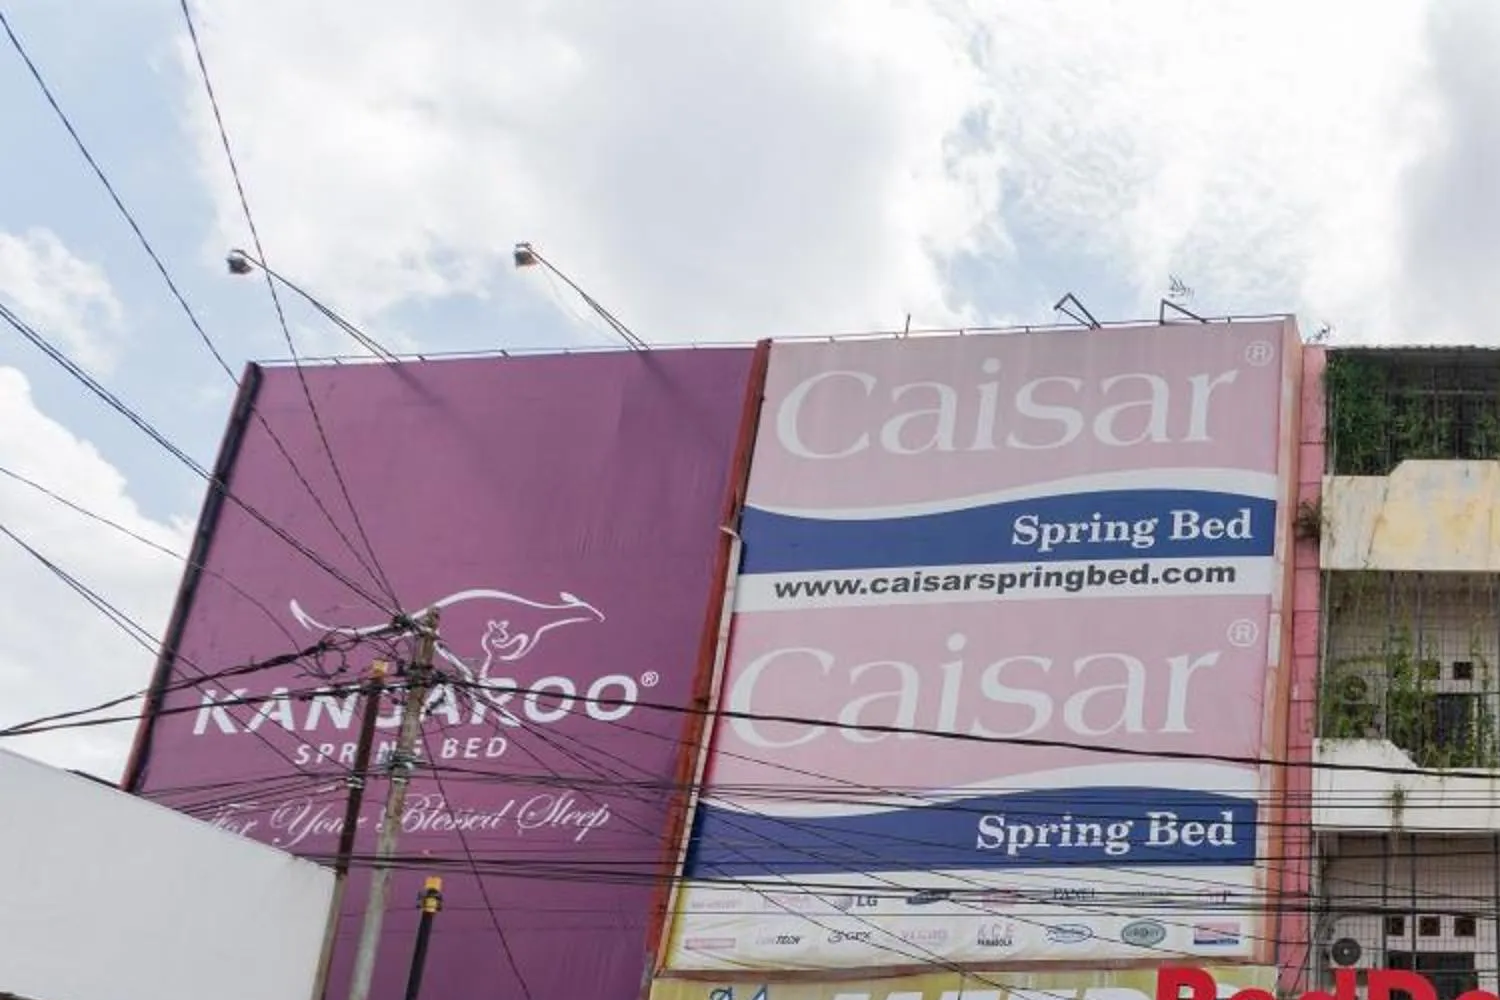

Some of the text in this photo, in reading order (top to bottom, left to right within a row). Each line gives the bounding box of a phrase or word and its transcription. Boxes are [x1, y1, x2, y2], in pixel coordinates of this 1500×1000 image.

[776, 358, 1238, 459] Caisar
[1011, 509, 1253, 551] Spring Bed
[773, 562, 1237, 599] www.caisarspringbed.com
[728, 632, 1221, 749] Caisar
[294, 736, 508, 765] SPRN BED
[517, 791, 612, 843] Sleep
[976, 812, 1236, 856] Spring Bed
